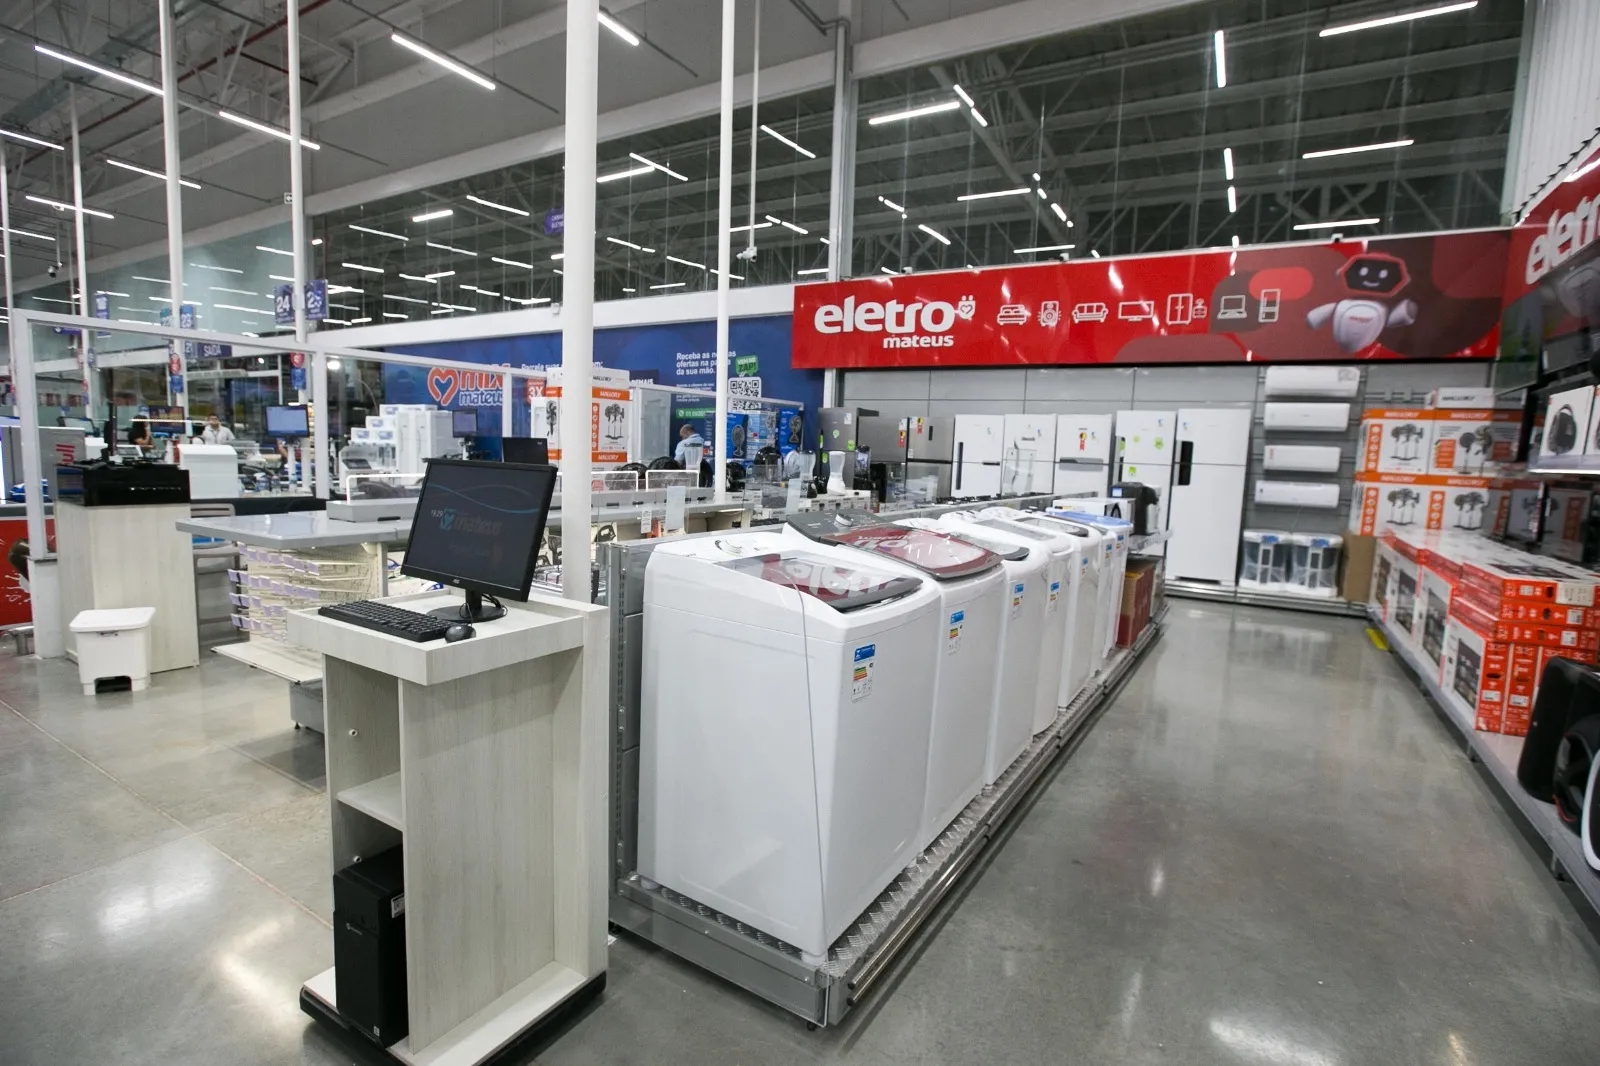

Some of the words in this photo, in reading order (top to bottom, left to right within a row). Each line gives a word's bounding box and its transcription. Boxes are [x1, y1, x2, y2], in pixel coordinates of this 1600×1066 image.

[276, 295, 290, 312] 24
[814, 295, 956, 334] eletro
[883, 334, 954, 349] mateus
[676, 352, 701, 361] Receba
[676, 359, 699, 368] ofertas
[700, 359, 709, 367] na
[676, 367, 685, 376] da
[459, 390, 503, 406] mateu
